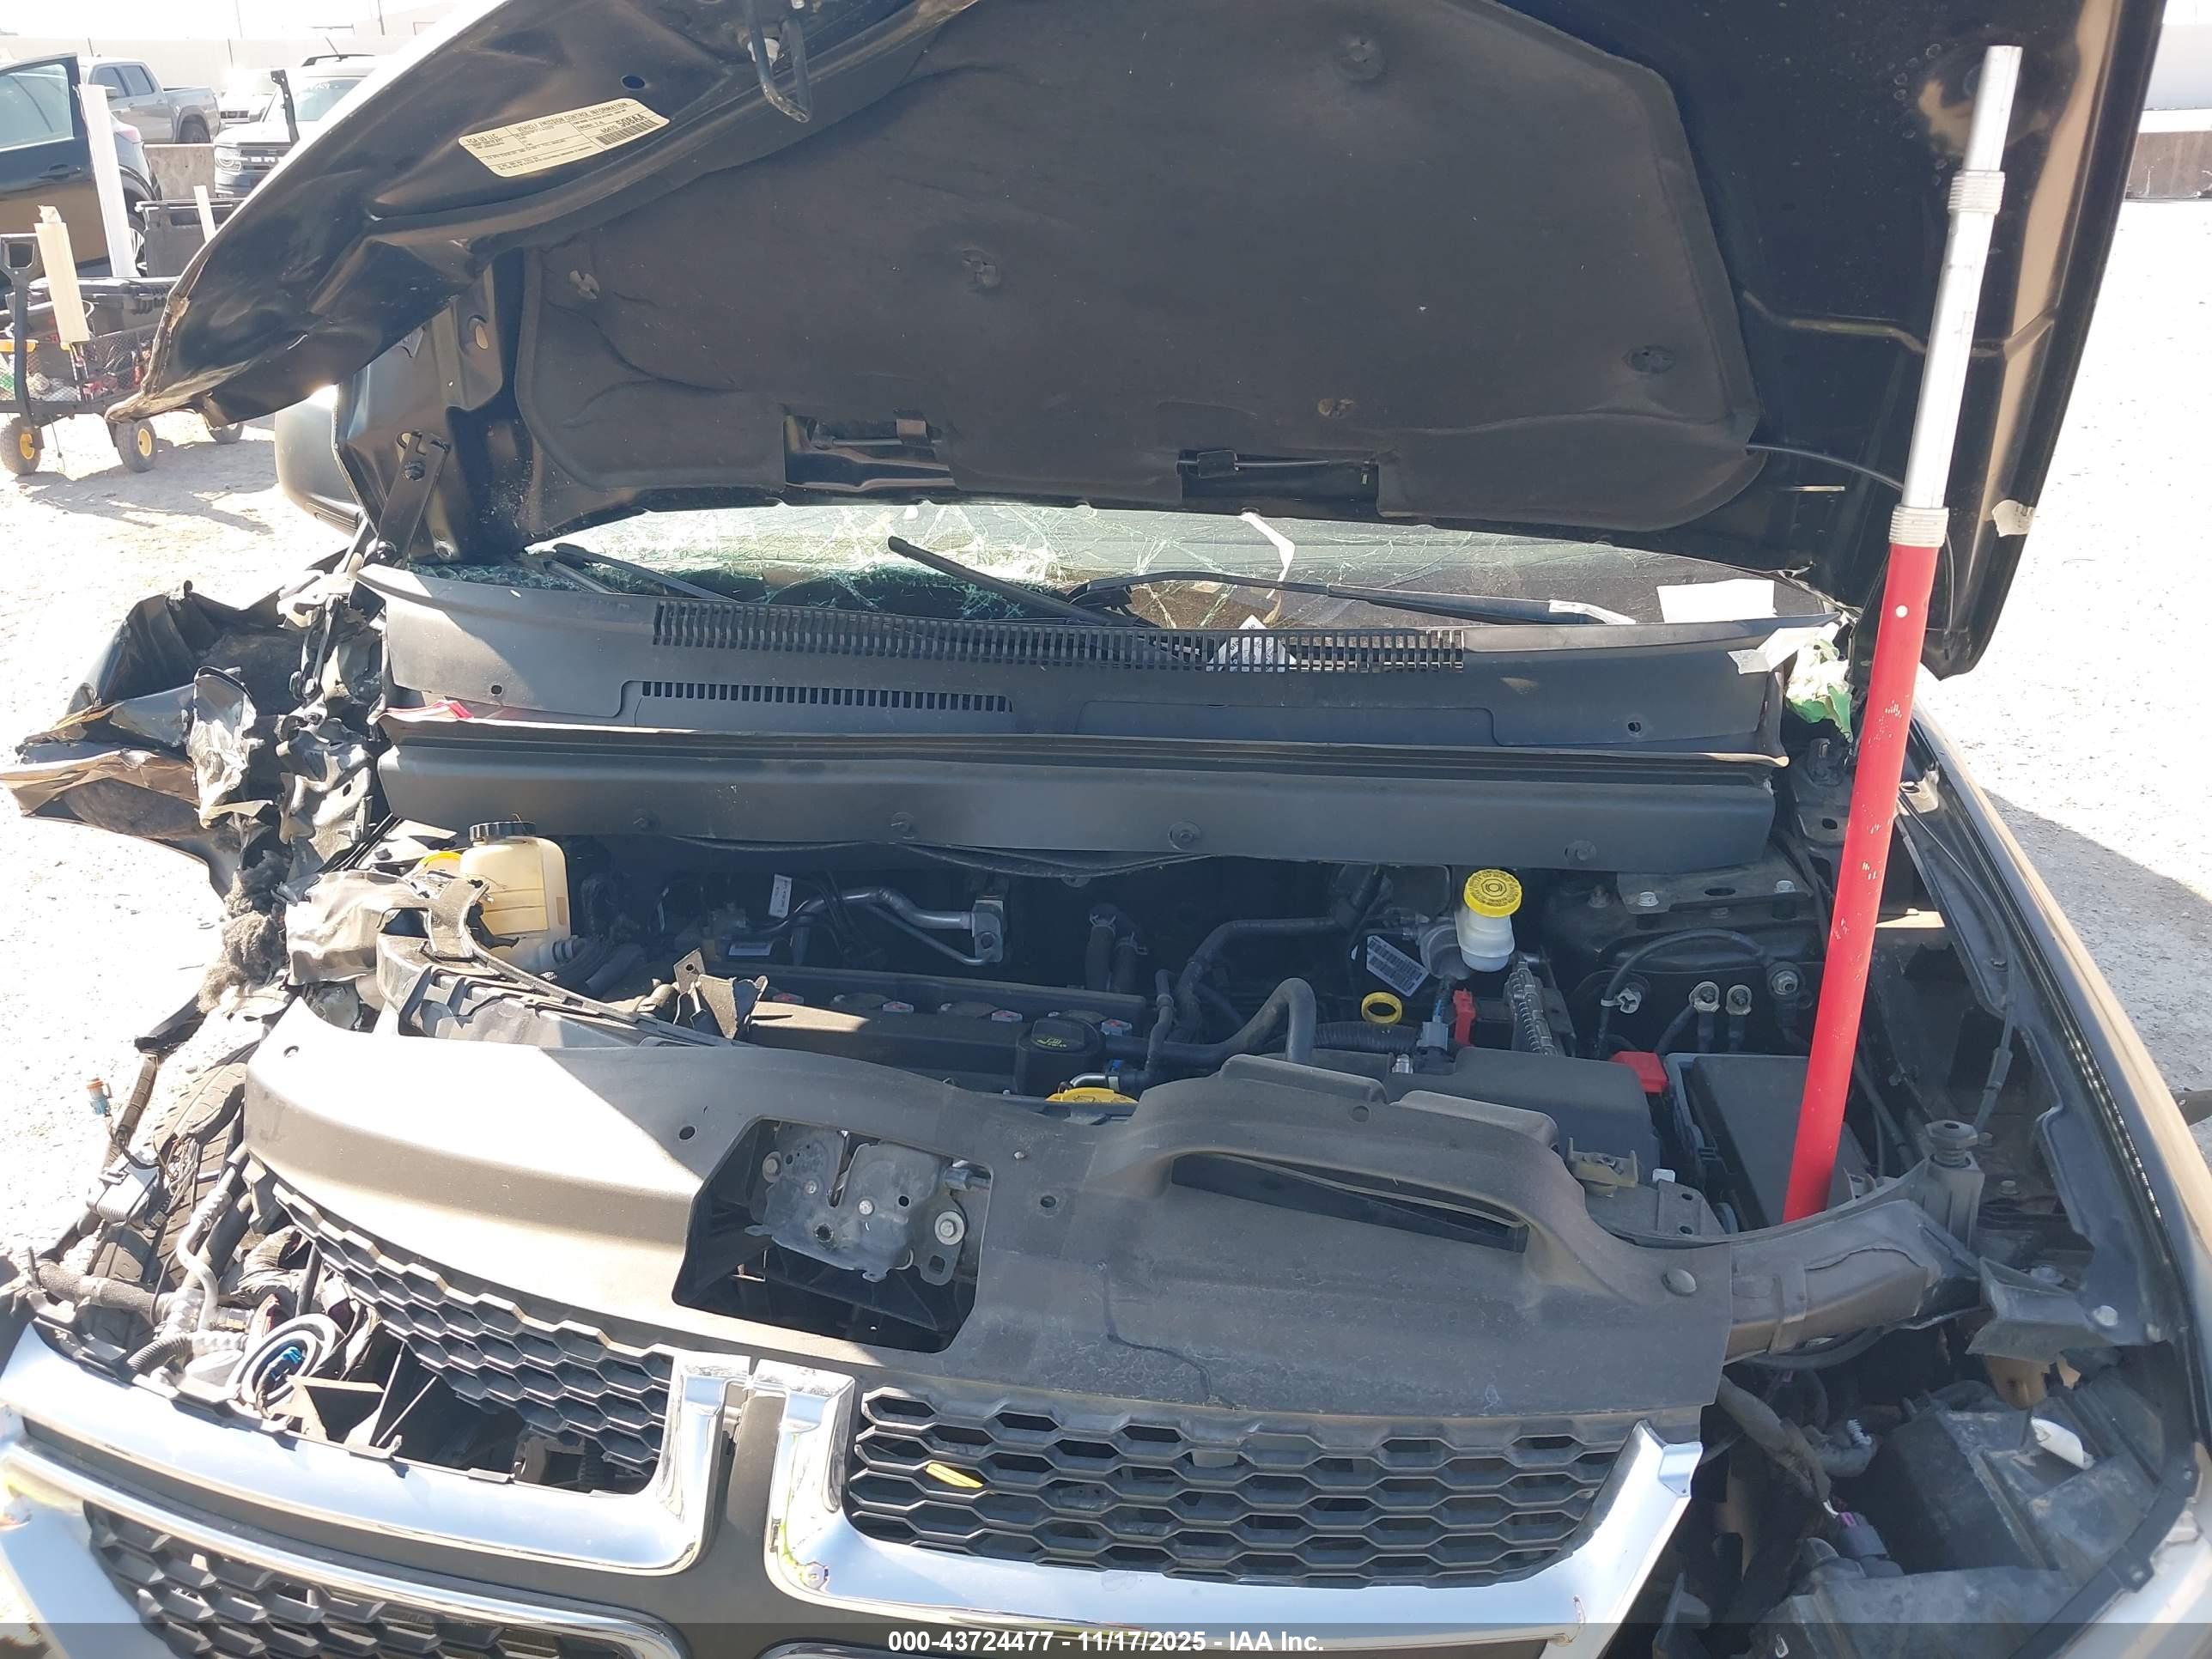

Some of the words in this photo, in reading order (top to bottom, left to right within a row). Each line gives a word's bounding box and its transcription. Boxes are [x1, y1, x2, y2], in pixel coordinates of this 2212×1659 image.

[516, 123, 538, 132] VEHICLE
[563, 111, 588, 122] CONTROL
[589, 101, 628, 115] INFORMATION
